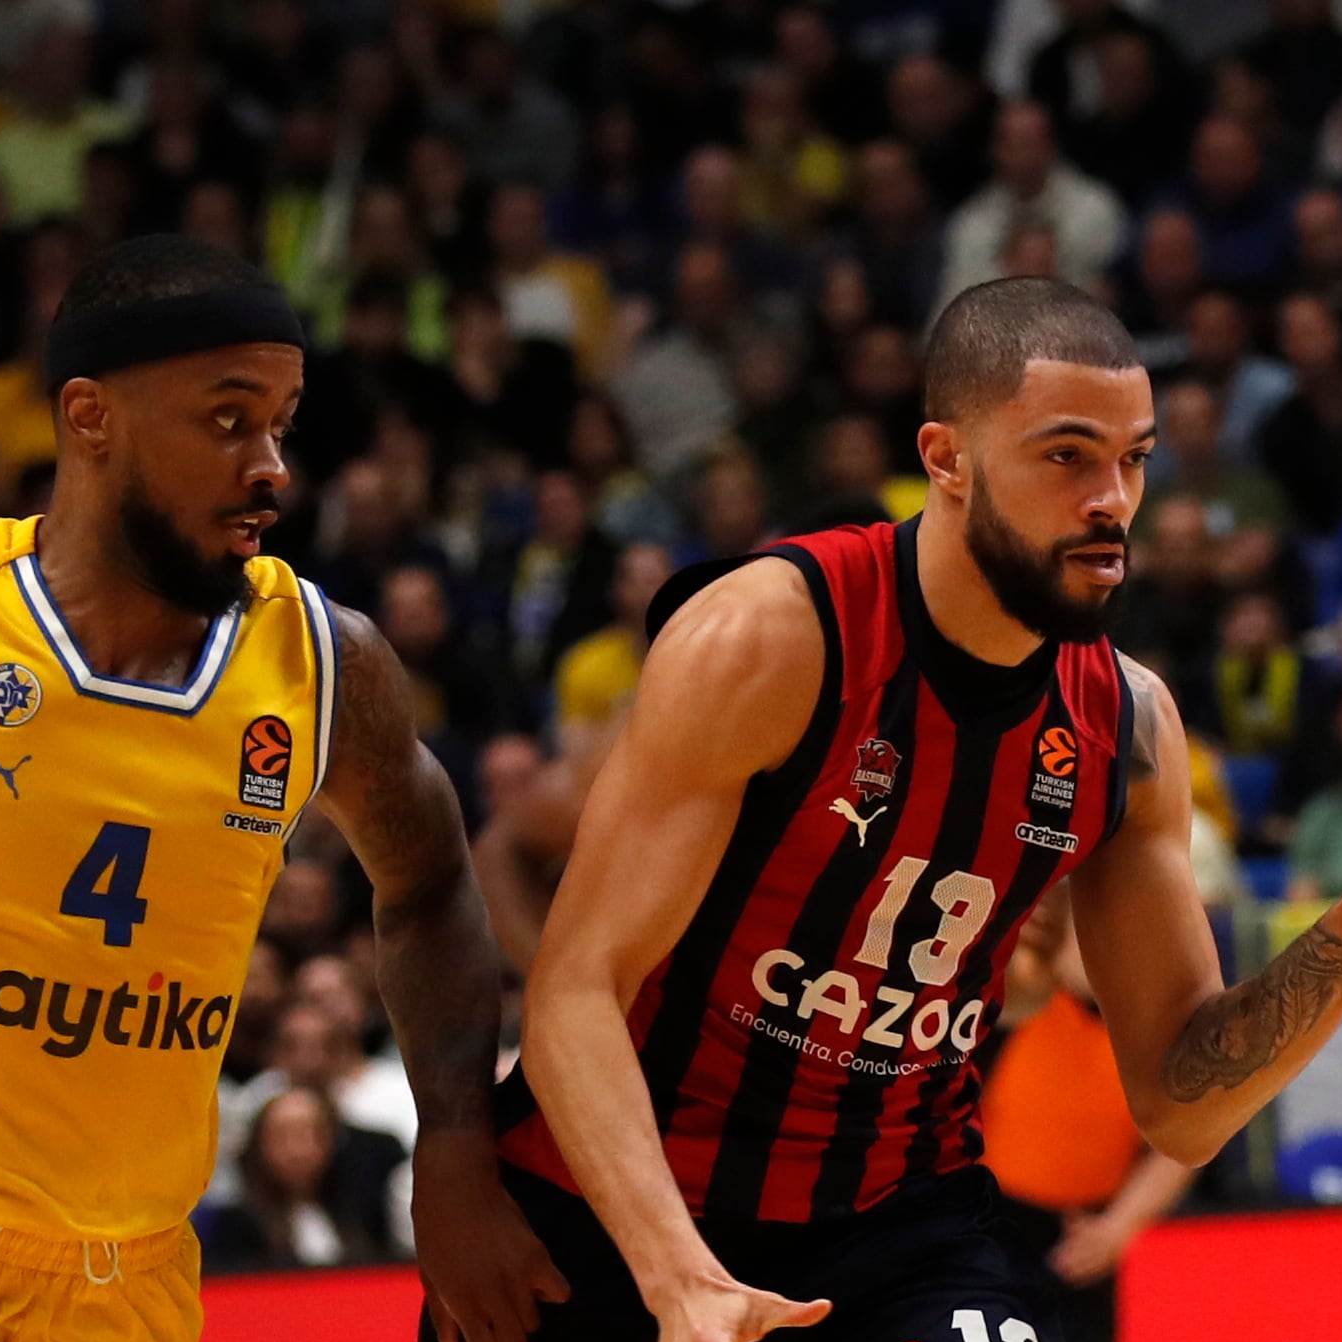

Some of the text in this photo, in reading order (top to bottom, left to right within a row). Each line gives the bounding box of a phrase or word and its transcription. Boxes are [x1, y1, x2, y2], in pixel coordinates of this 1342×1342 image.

[243, 784, 282, 799] AIRLINES
[244, 774, 284, 789] TURKISH
[1032, 783, 1073, 800] AIRLINES
[1035, 773, 1075, 791] TURKISH
[223, 812, 282, 835] oneteam
[1017, 824, 1078, 851] oneteam
[60, 822, 151, 946] 4
[853, 856, 996, 987] 13
[729, 1003, 832, 1063] Encuentra.
